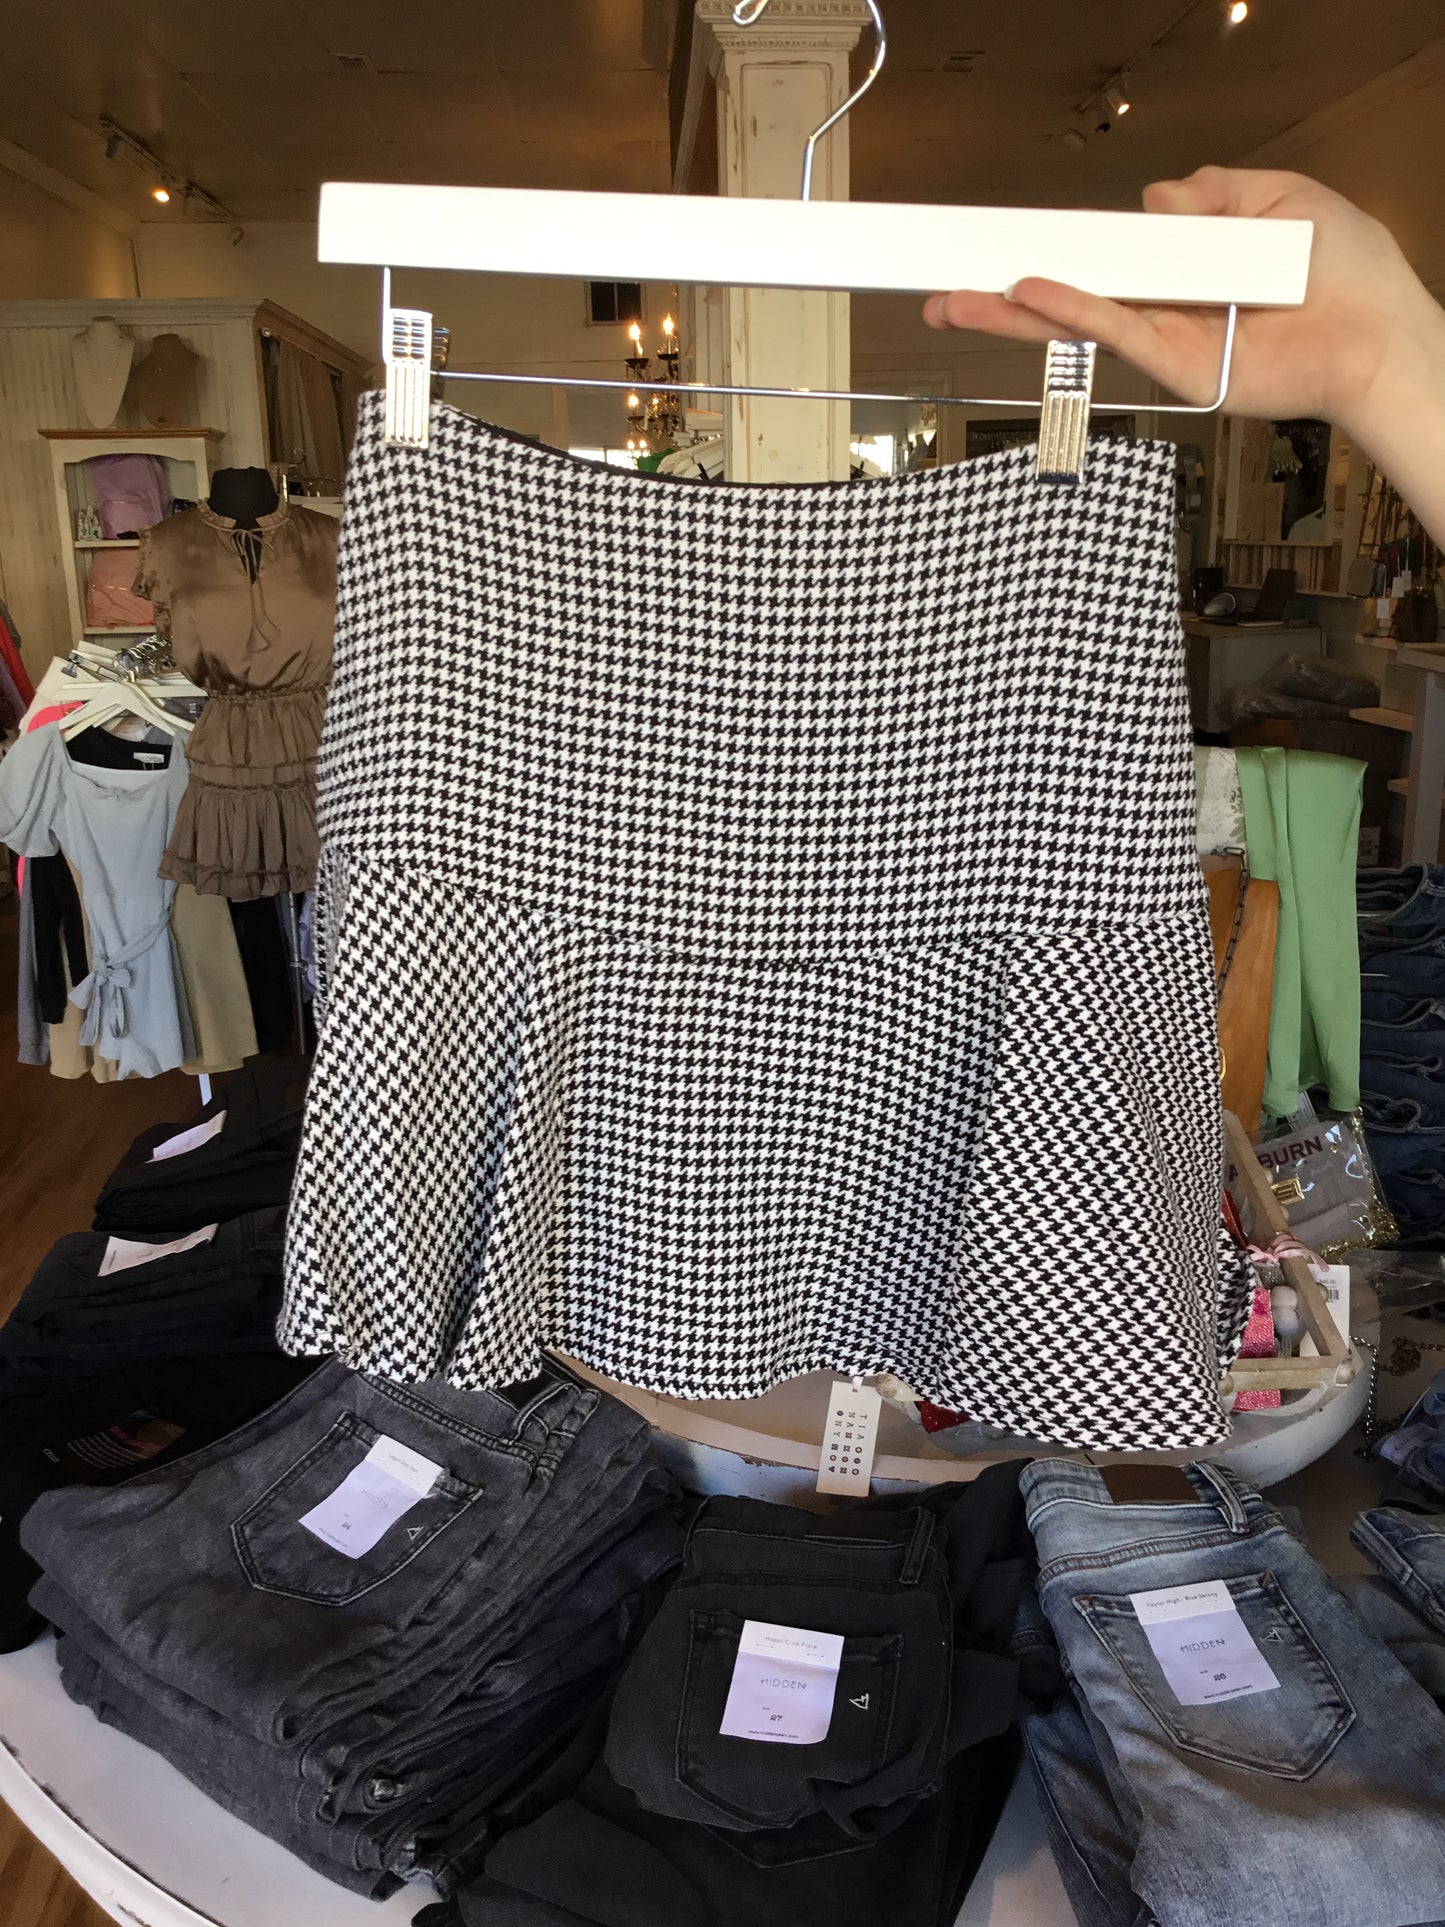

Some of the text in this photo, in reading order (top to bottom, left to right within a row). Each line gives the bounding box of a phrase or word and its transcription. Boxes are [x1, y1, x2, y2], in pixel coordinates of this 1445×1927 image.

[1228, 1136, 1323, 1182] ABURN
[1180, 1638, 1226, 1653] HIDDEN
[760, 1678, 807, 1690] HIDDEN
[770, 1714, 783, 1722] 27
